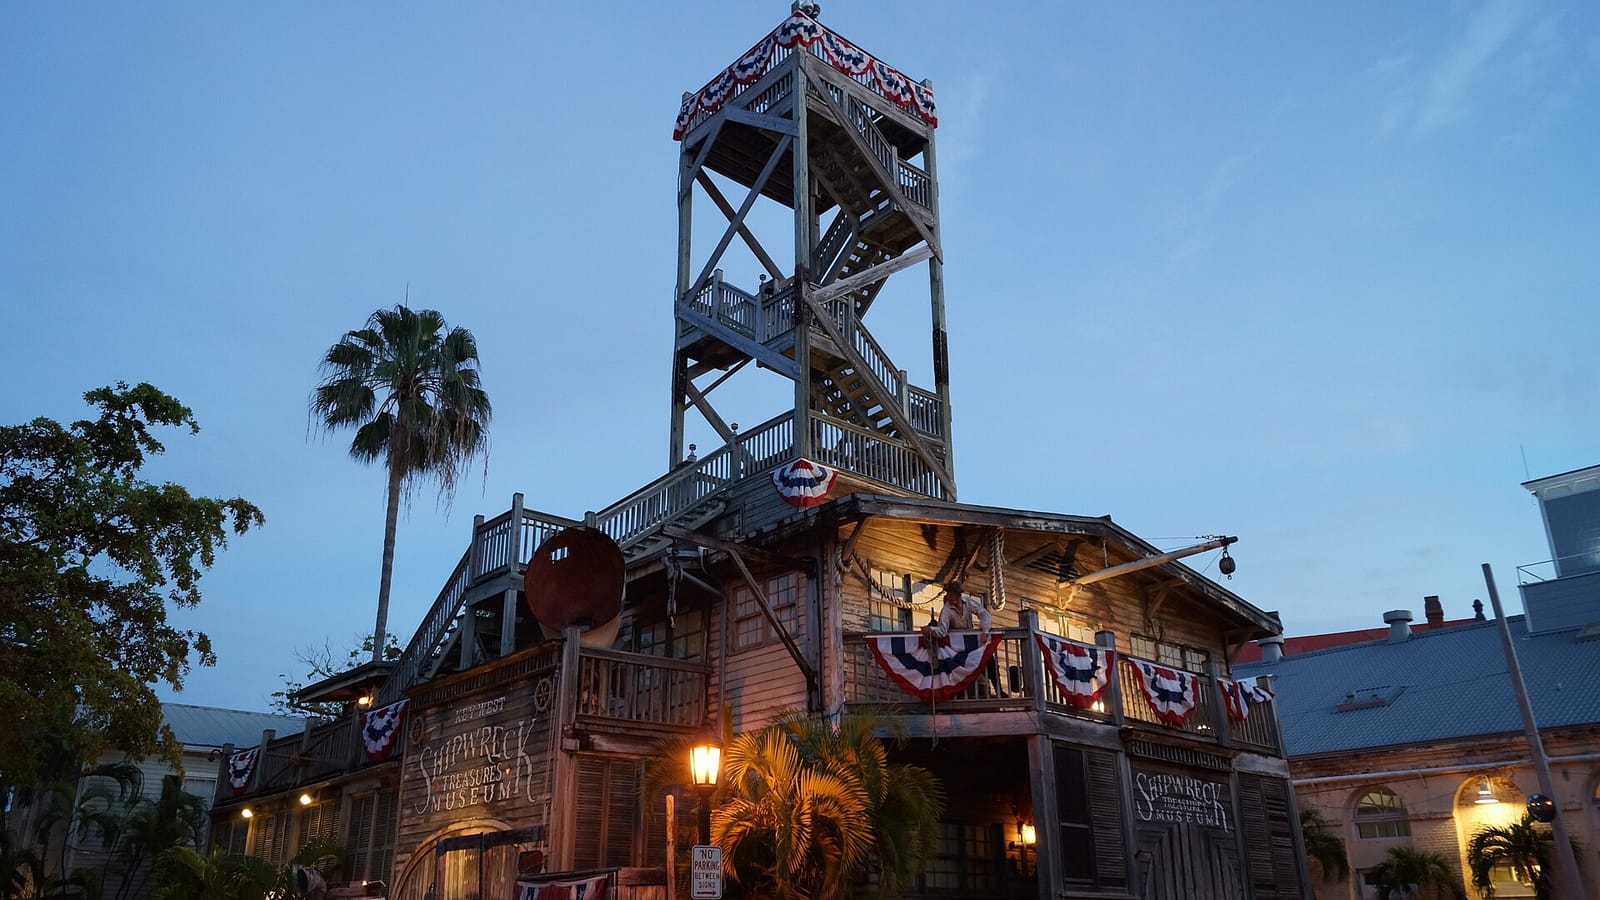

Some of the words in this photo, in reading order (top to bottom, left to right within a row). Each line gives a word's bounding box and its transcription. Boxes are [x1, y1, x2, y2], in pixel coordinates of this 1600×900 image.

[455, 706, 477, 723] KEY
[478, 696, 506, 717] WEST
[415, 717, 537, 815] SHIPWRECK
[443, 762, 502, 791] TREASURES
[431, 781, 511, 812] MUSEUM
[1136, 772, 1230, 833] SHIPWRECK
[1156, 809, 1214, 826] MUSEUM
[695, 861, 720, 870] PARKING
[695, 872, 719, 880] BETWEEN
